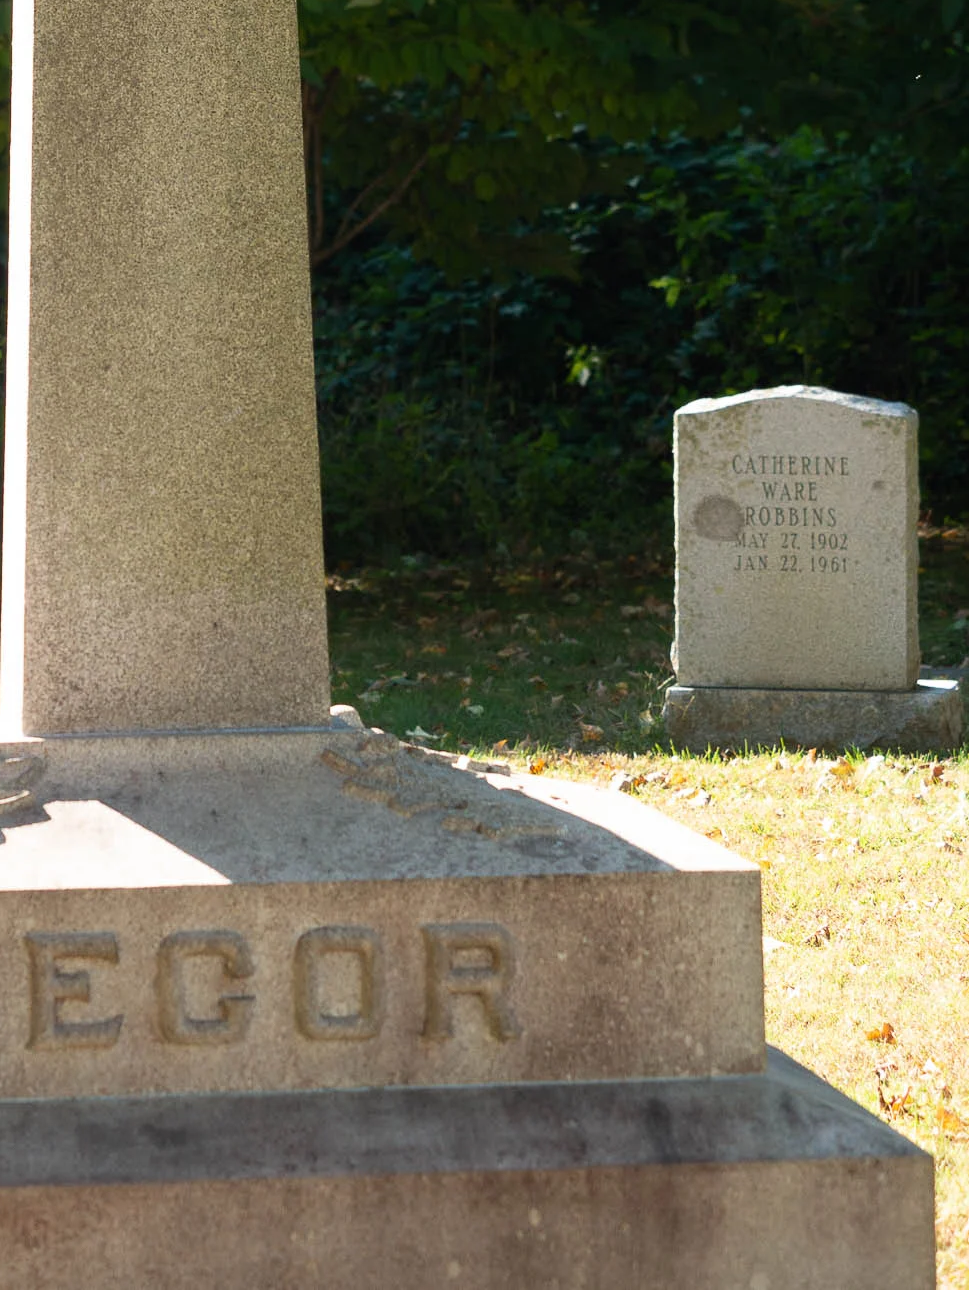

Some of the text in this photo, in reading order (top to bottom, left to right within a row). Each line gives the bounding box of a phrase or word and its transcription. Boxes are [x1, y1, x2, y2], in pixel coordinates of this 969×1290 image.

[732, 454, 850, 476] CATHERINE
[762, 481, 817, 501] WARE
[745, 506, 837, 528] ROBBINS
[735, 532, 769, 549] MAY
[810, 532, 848, 550] 1902
[811, 555, 847, 573] 1961
